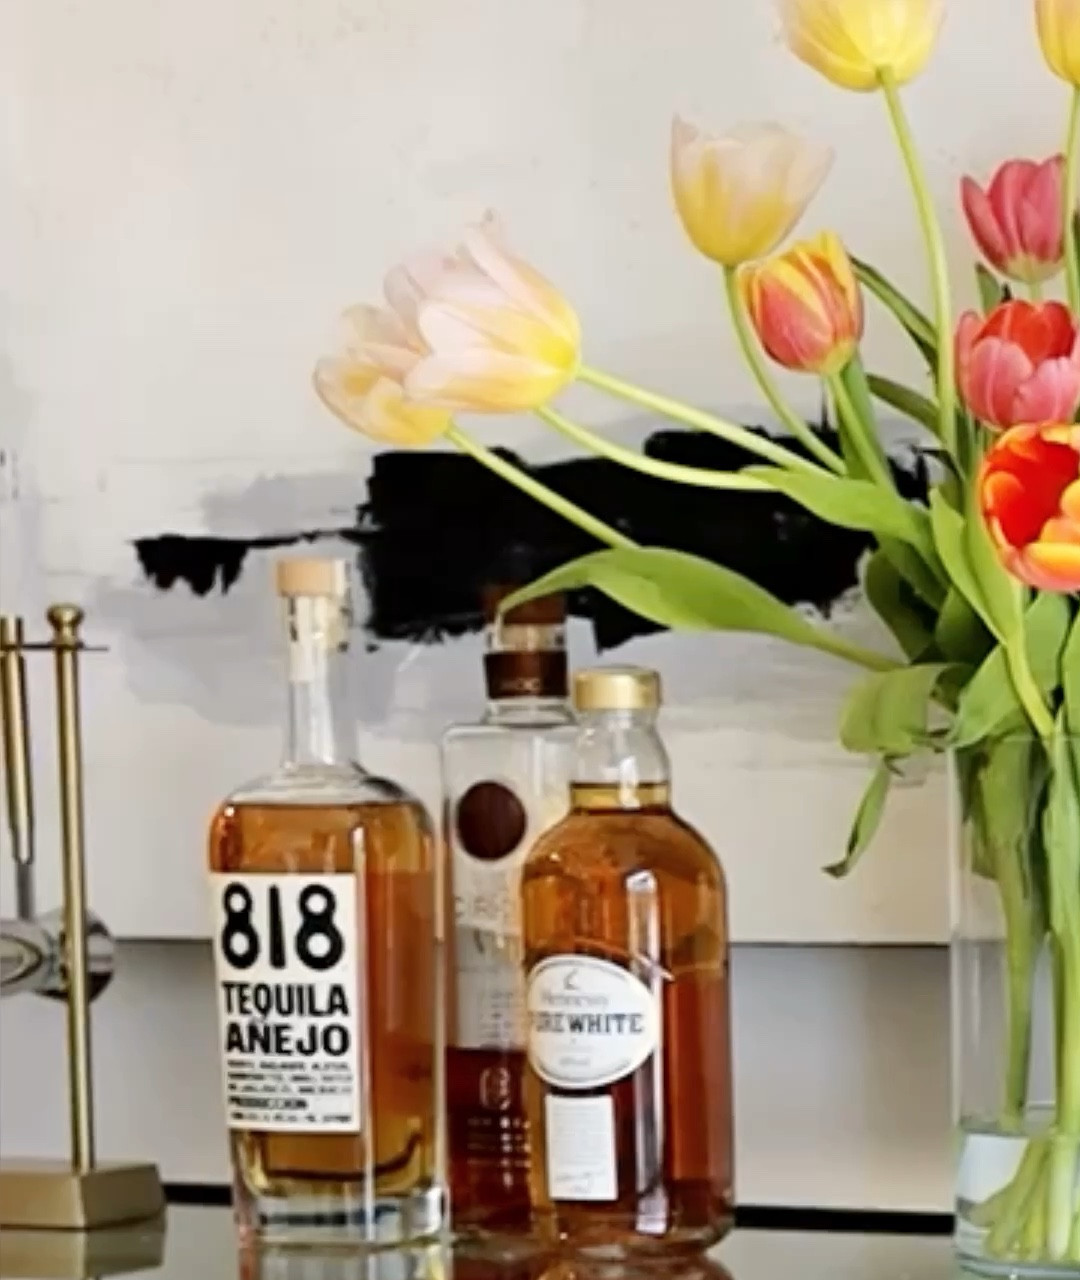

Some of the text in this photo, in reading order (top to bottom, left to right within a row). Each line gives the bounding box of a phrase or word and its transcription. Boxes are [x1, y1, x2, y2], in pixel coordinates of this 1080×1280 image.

[221, 882, 345, 970] 818
[222, 981, 350, 1021] TEQUILA
[226, 1012, 351, 1056] AÑEJO
